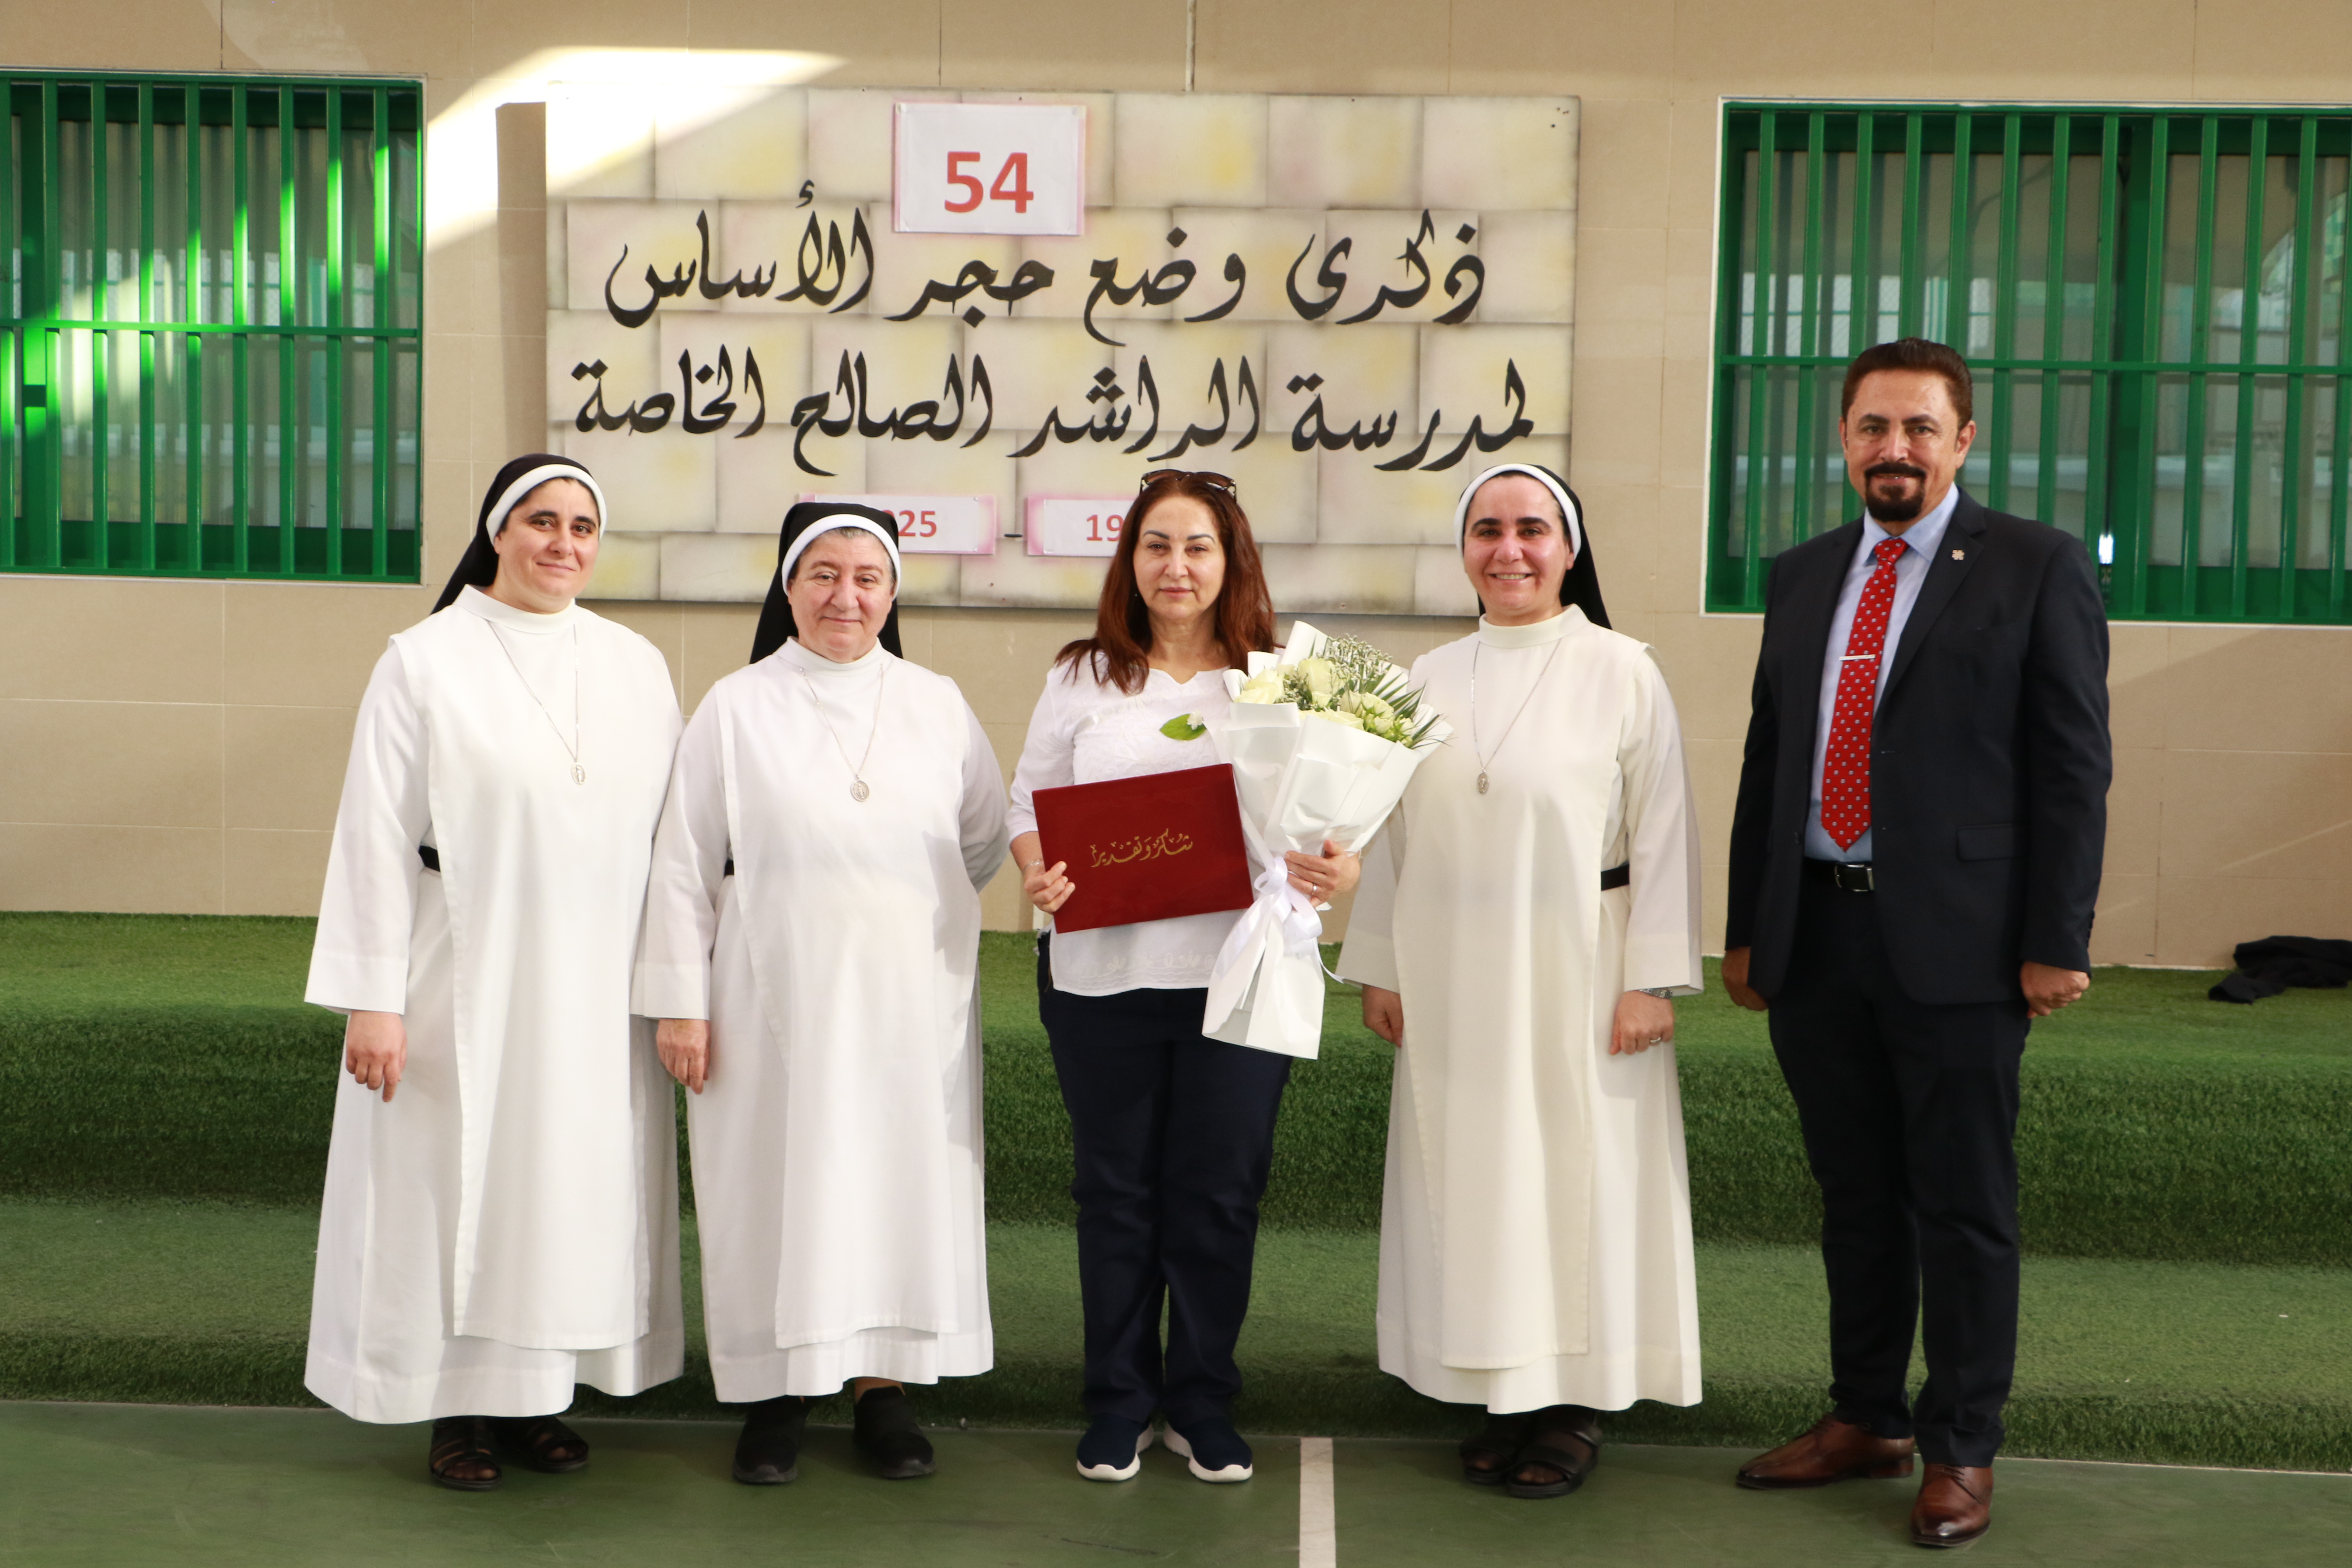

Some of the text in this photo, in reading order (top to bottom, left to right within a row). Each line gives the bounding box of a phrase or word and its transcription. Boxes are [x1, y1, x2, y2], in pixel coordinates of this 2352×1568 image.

[945, 152, 1034, 214] 54
[605, 180, 1485, 346] ذكرى وضع حجر الأساس
[571, 344, 1534, 476] لمدرسة الراشد الصالح الخاصة
[882, 510, 937, 537] 25
[1087, 514, 1124, 542] 19
